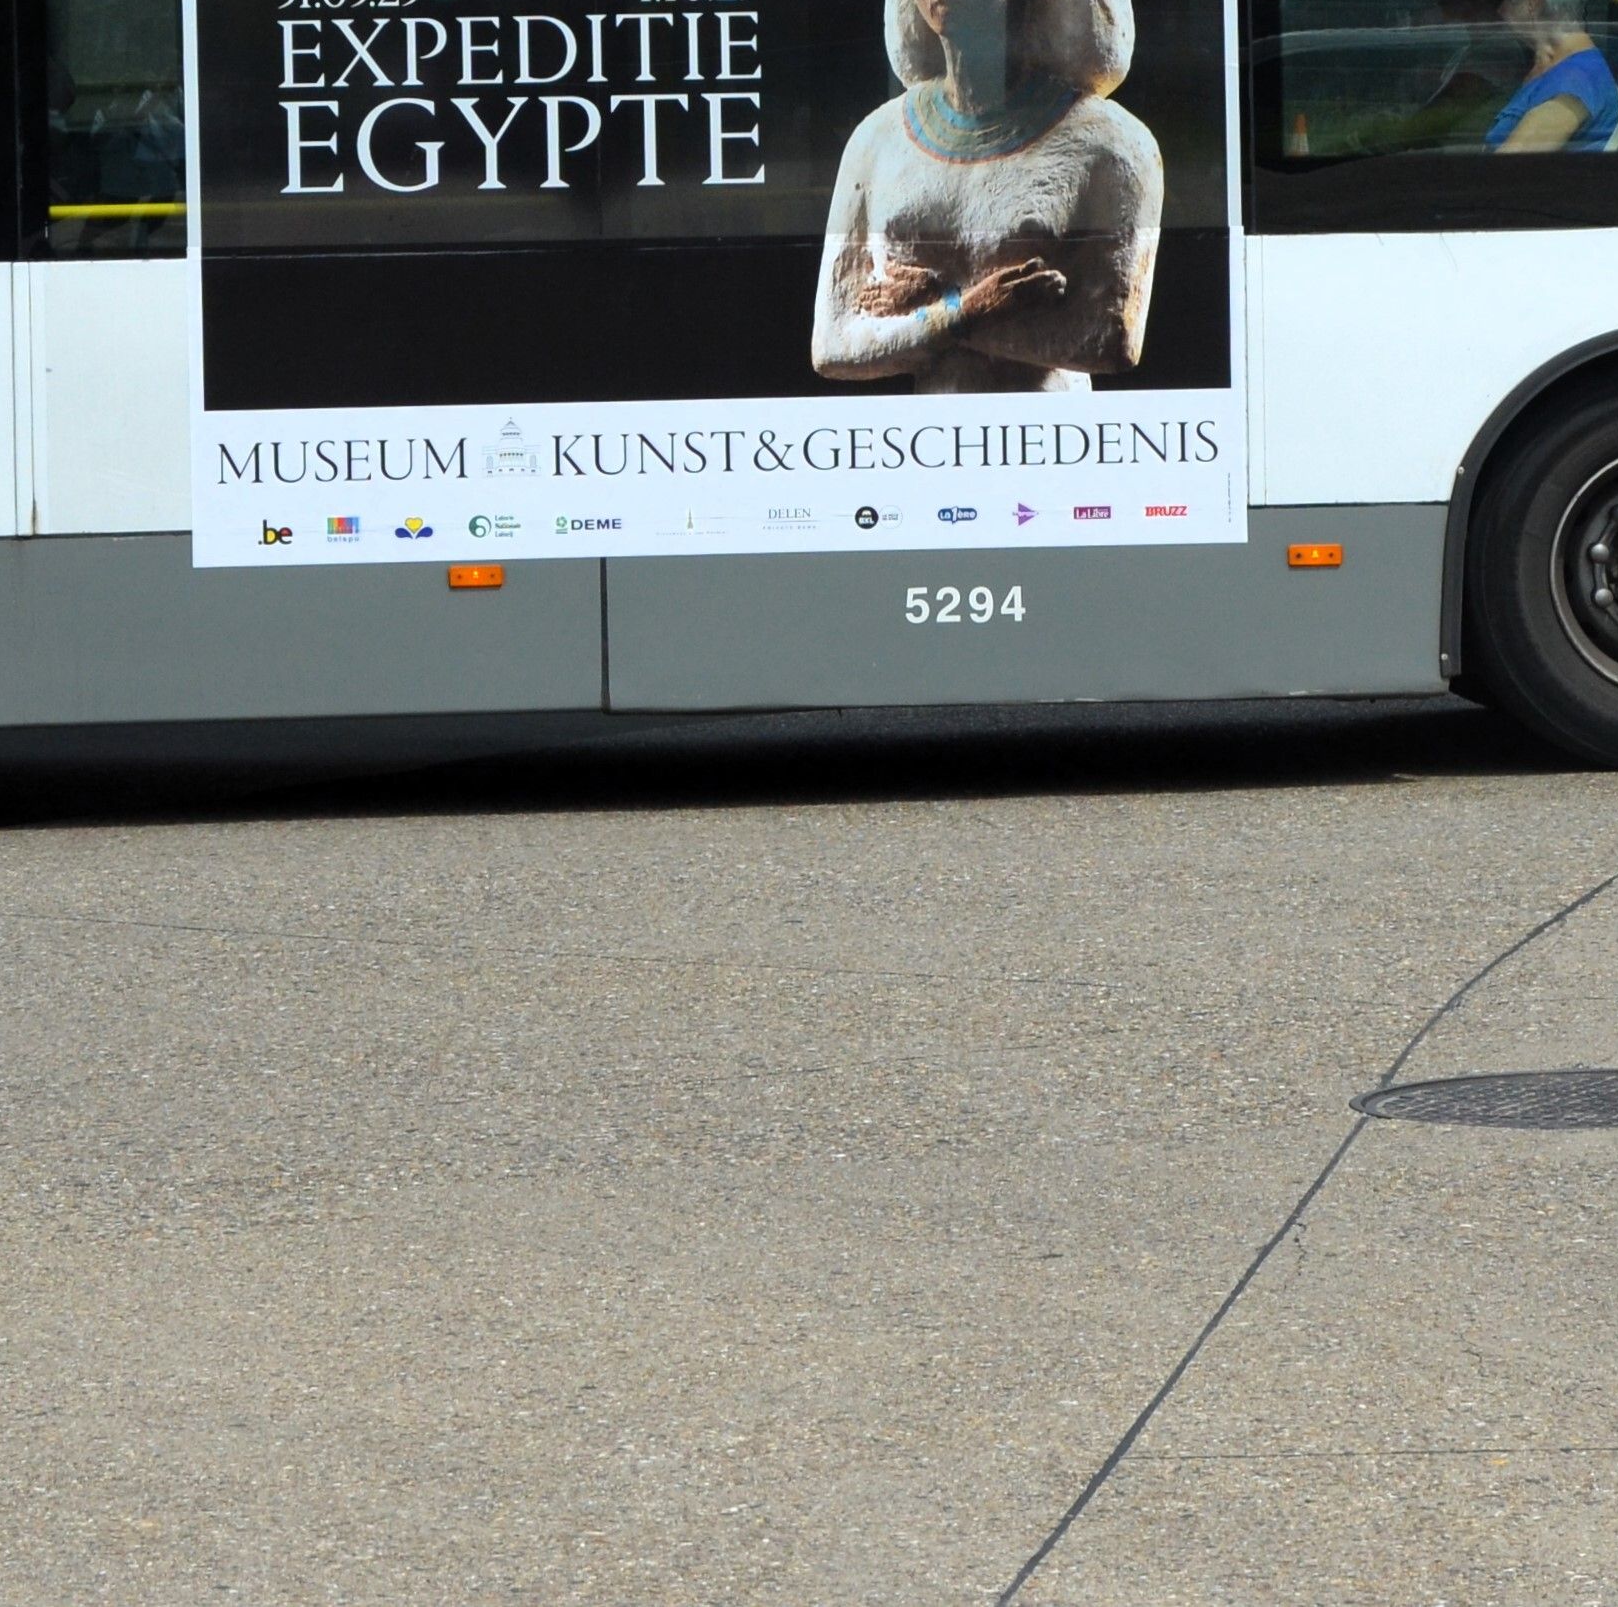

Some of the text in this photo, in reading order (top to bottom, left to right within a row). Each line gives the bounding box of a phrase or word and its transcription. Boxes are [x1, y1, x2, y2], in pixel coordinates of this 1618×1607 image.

[277, 11, 763, 89] EXPEDITIE
[278, 91, 766, 194] EGYPTE
[218, 437, 468, 484] MUSEUM
[571, 518, 622, 531] DEME
[768, 507, 812, 519] DELEN
[1145, 505, 1188, 517] BRUZZ
[905, 585, 1026, 624] 5294
